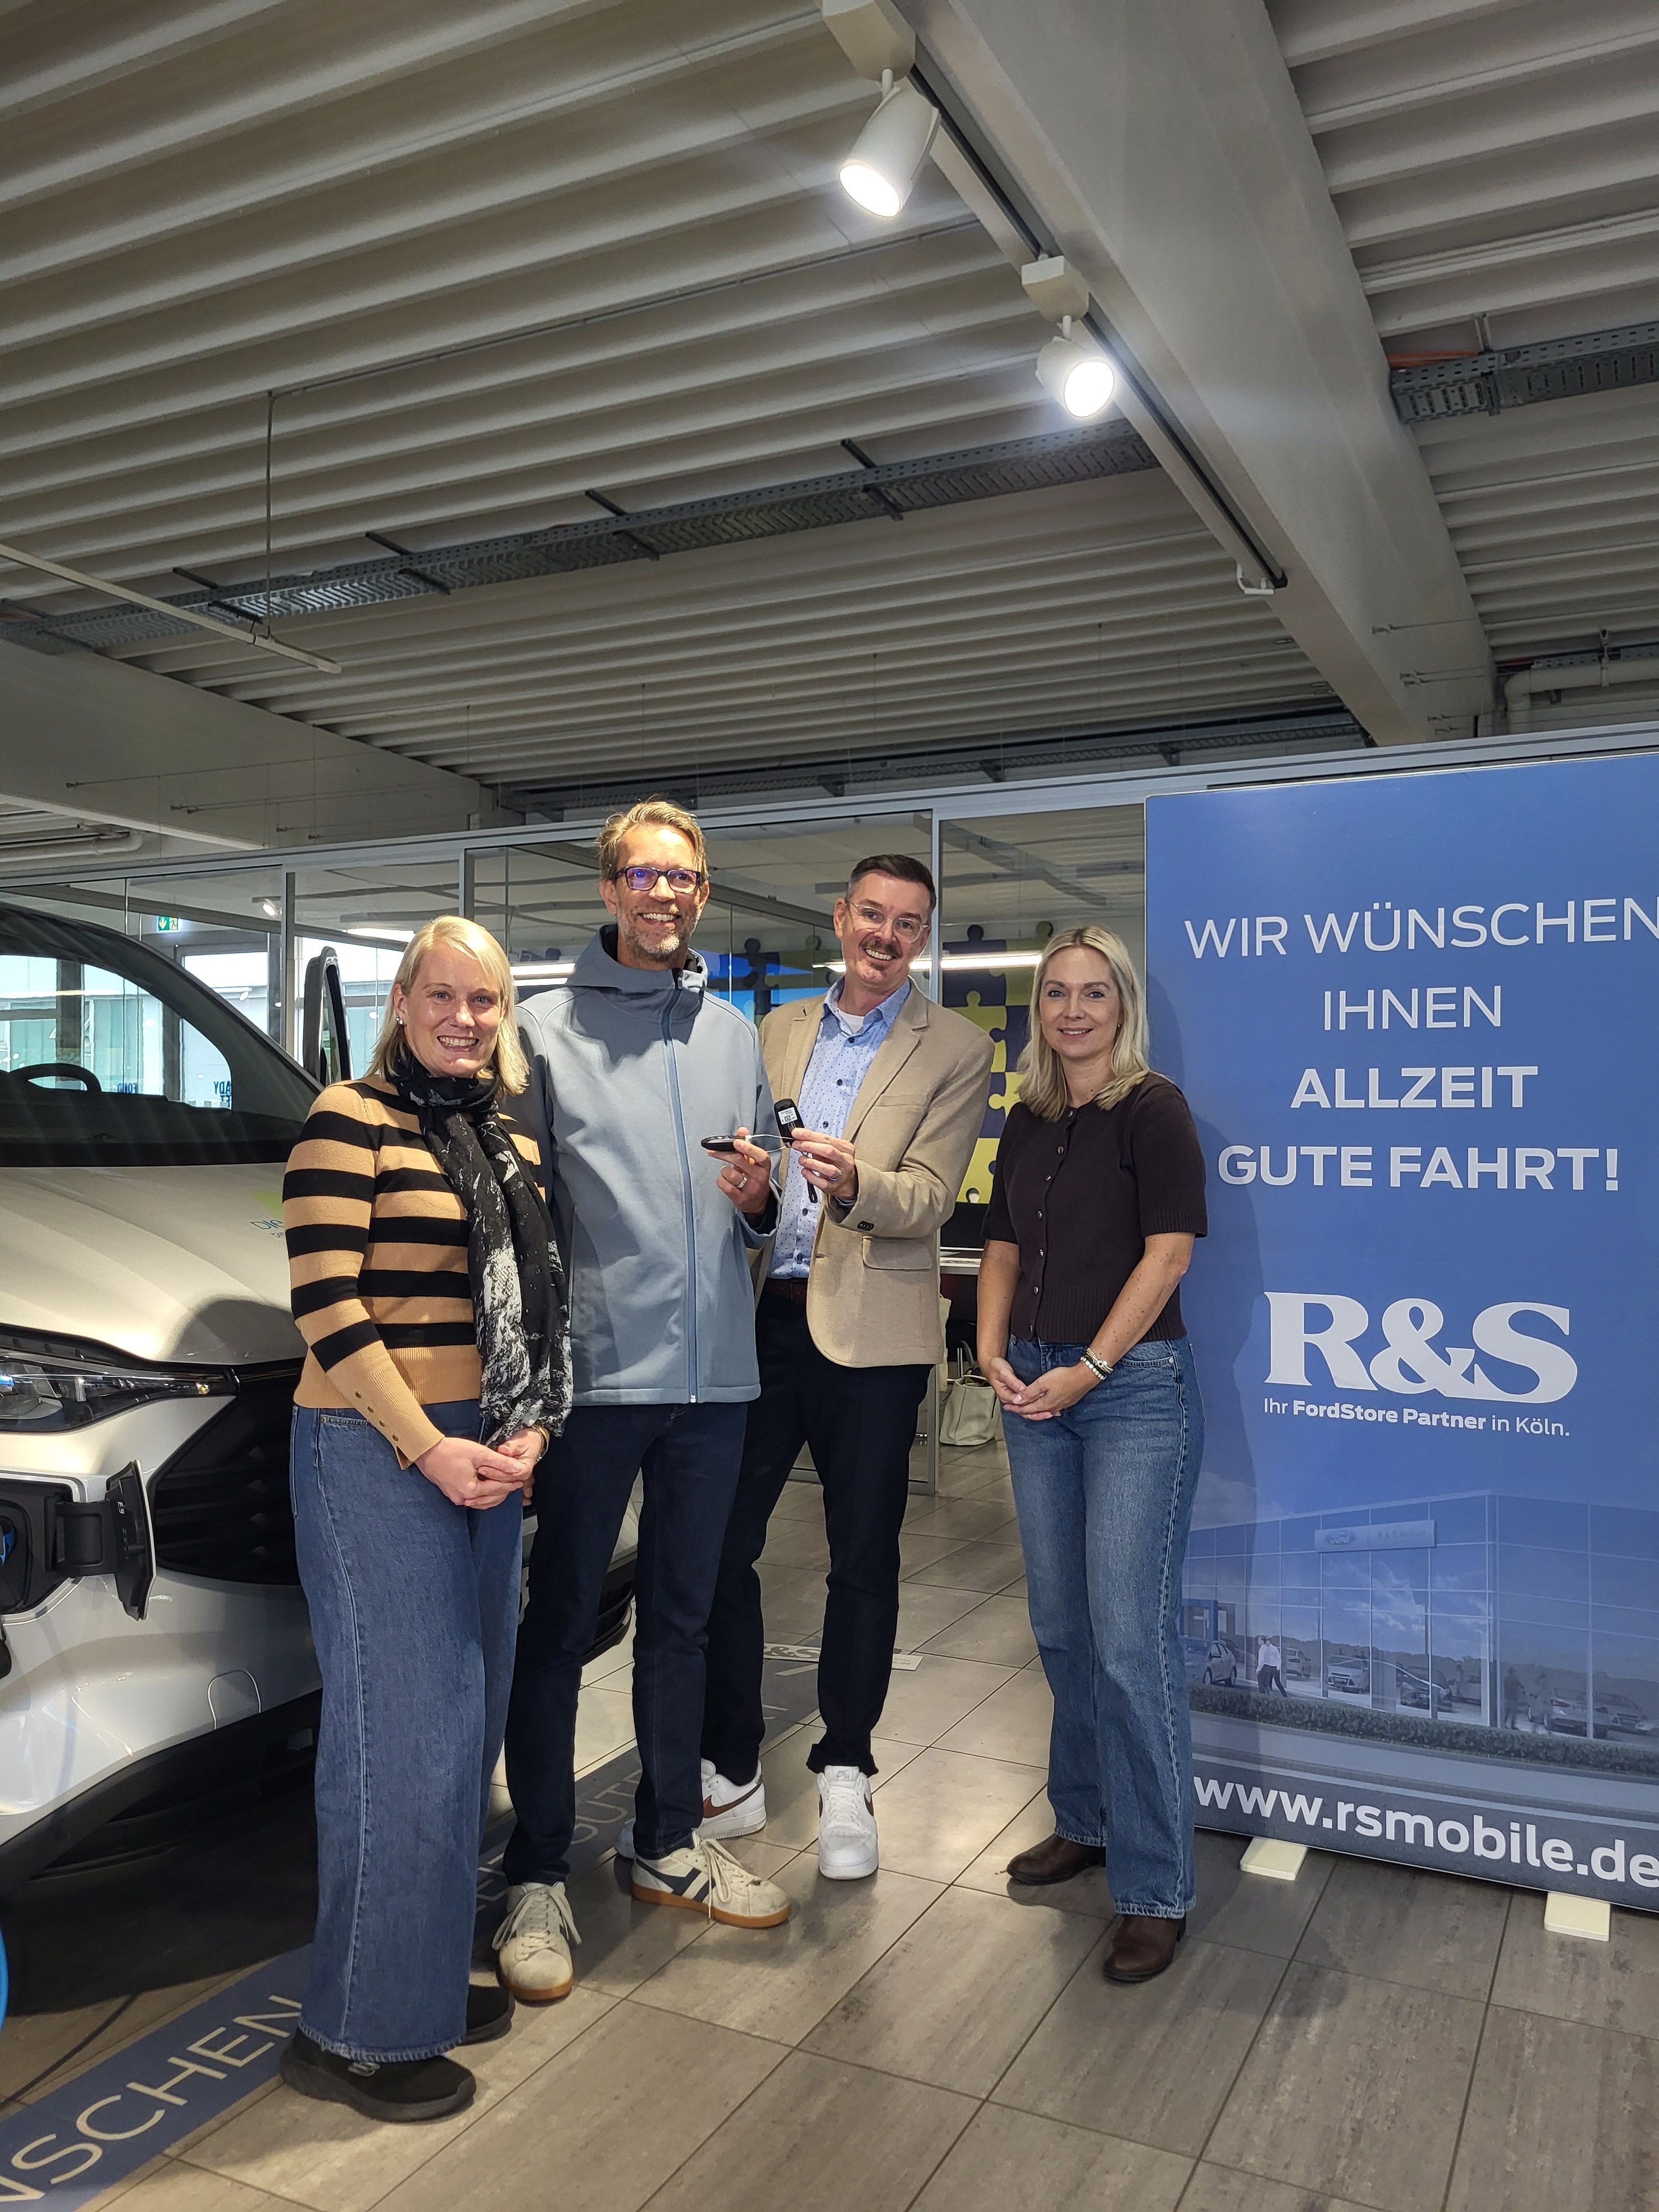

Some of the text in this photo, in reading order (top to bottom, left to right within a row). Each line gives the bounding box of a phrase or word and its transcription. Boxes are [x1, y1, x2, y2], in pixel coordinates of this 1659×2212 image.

[1185, 896, 1659, 959] WIR WÜNSCHEN
[1324, 985, 1501, 1031] IHNEN
[1290, 1066, 1538, 1108] ALLZEIT
[1218, 1145, 1619, 1191] GUTE FAHRT!
[1264, 1291, 1578, 1404] R&S
[1264, 1398, 1571, 1437] Ihr FordStore Partner in Köln.
[1193, 1776, 1659, 1888] www.rsmobile.de
